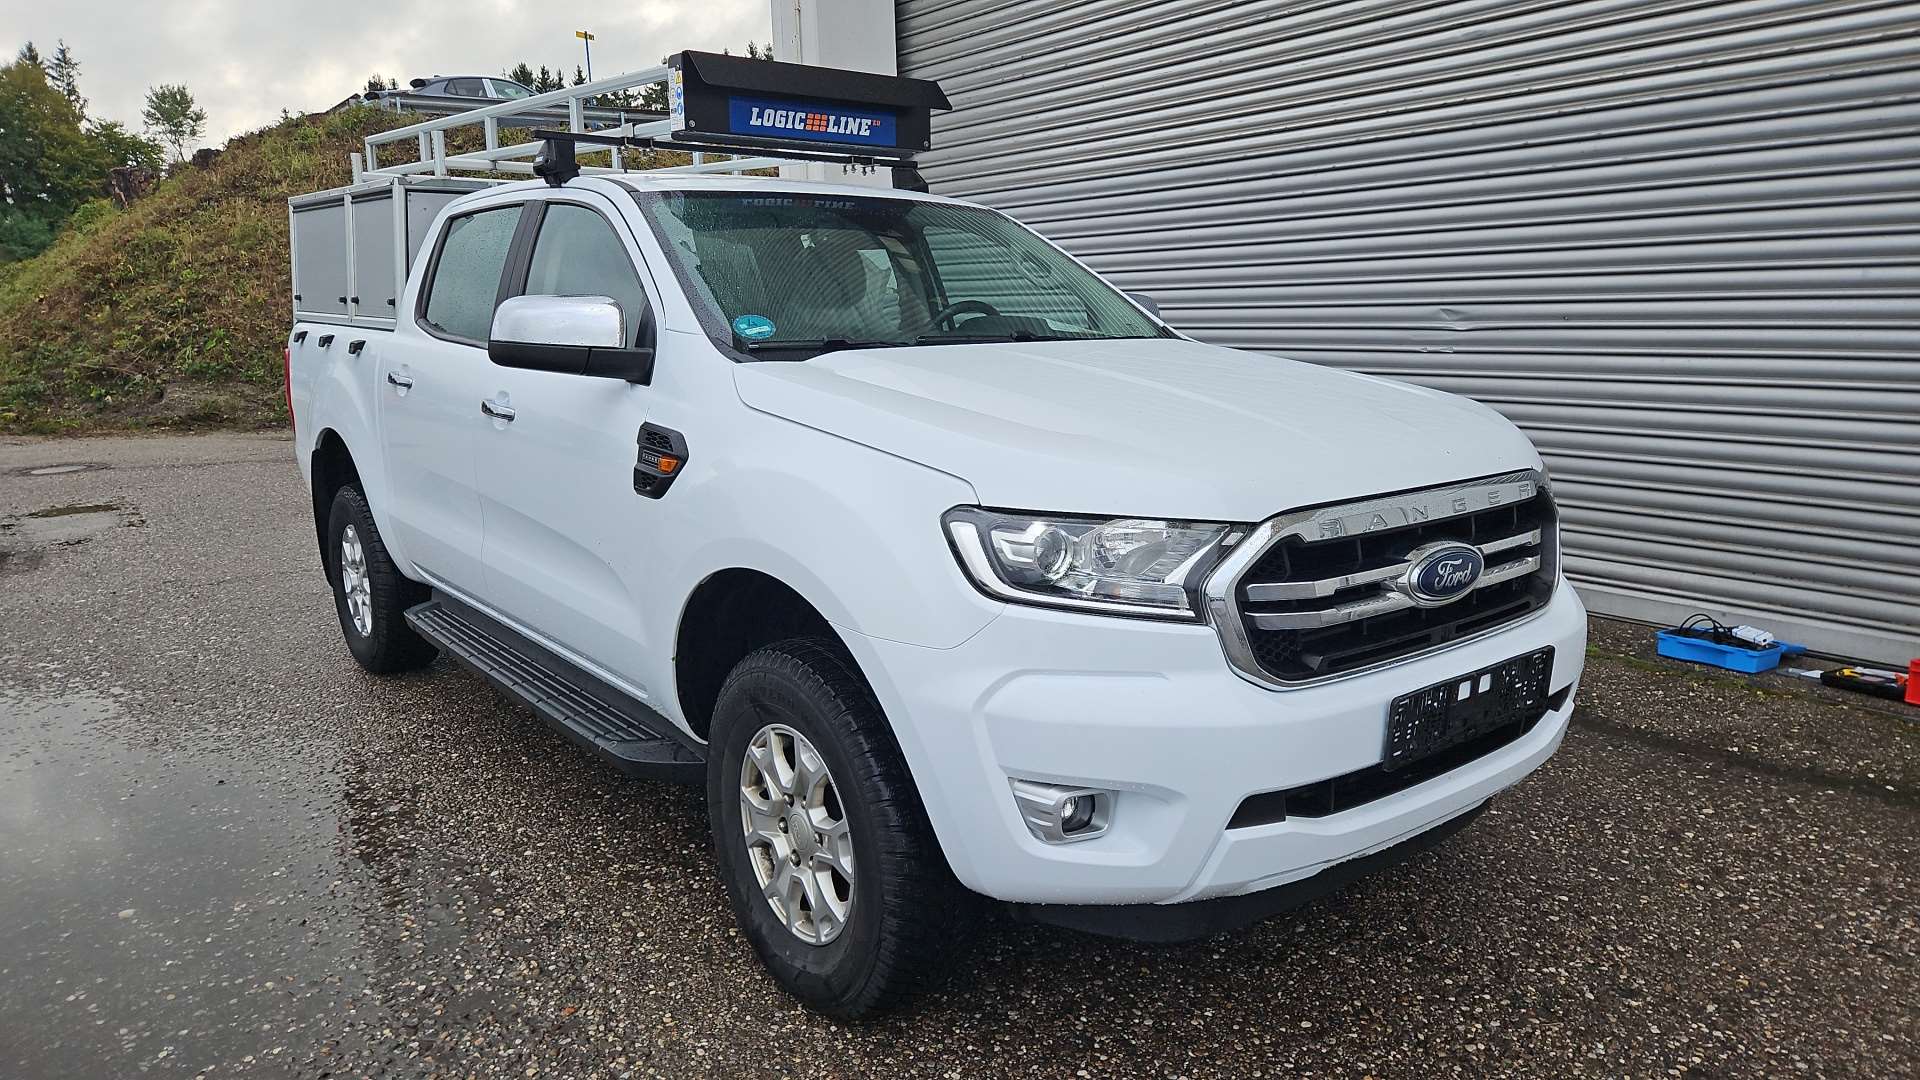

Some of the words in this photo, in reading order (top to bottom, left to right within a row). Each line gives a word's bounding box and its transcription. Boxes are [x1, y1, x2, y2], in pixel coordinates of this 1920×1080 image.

[749, 107, 806, 130] LOGIC
[826, 115, 872, 136] LINE
[1434, 558, 1473, 590] Ford
